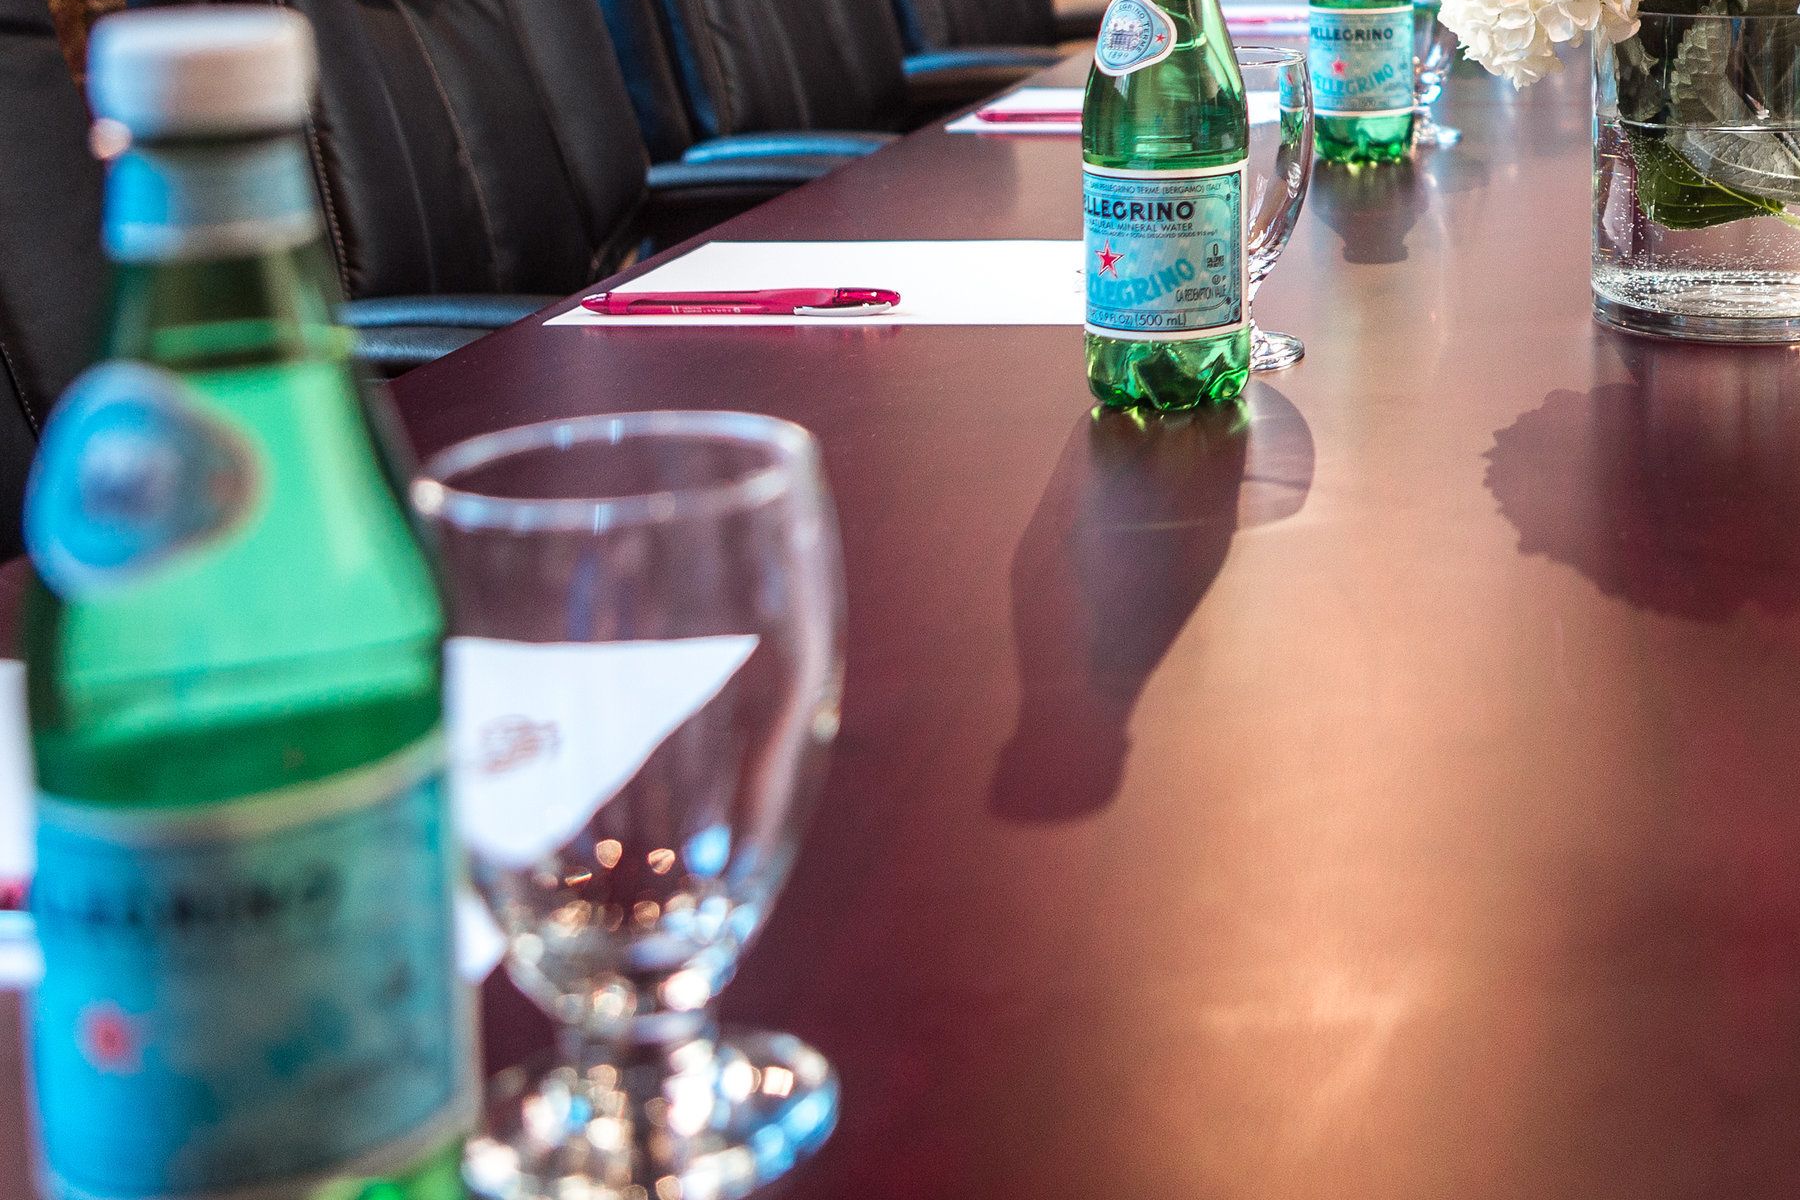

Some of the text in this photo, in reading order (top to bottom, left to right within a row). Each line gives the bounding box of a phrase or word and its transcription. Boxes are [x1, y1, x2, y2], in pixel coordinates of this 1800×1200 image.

[1137, 185, 1160, 193] TERME
[1162, 184, 1205, 195] (BERGAMO)
[1117, 223, 1157, 233] MINERAL
[1161, 222, 1194, 231] WATER
[1213, 243, 1219, 256] 0
[1135, 313, 1162, 326] (500
[1167, 313, 1187, 326] mL)
